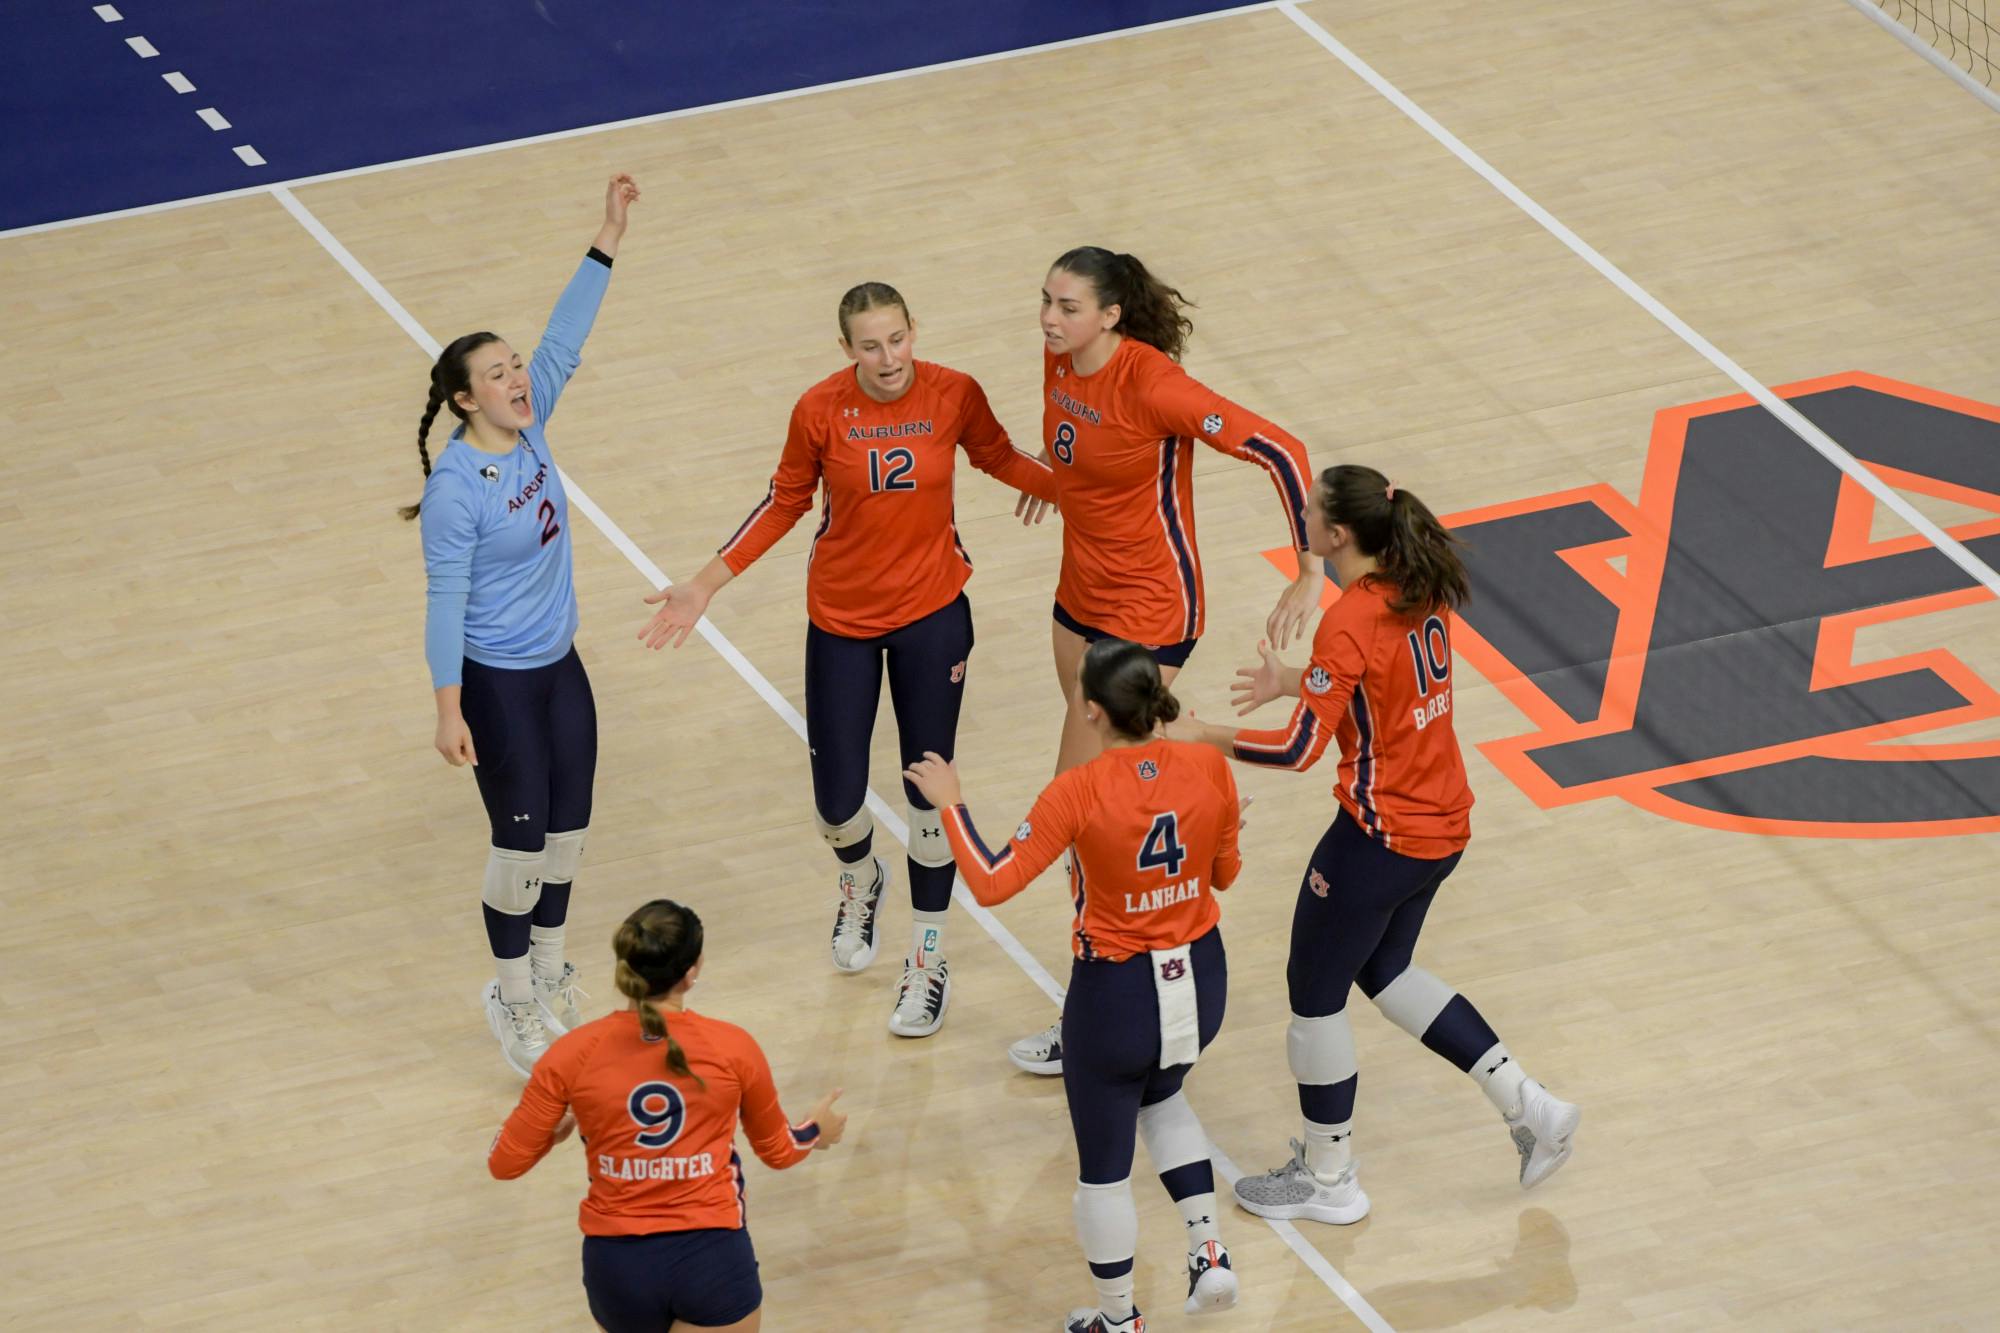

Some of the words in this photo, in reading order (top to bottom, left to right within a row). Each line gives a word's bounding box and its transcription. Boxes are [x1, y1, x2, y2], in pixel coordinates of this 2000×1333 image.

[1051, 386, 1101, 425] AUBURN
[847, 420, 932, 440] AUBURN
[1053, 421, 1076, 465] 8
[868, 447, 916, 493] 12
[537, 498, 560, 546] 2
[1407, 615, 1448, 697] 10
[1136, 811, 1186, 877] 4
[1125, 878, 1199, 913] LANHAM
[627, 1080, 686, 1149] 9
[598, 1152, 714, 1181] SLAUGHTER
